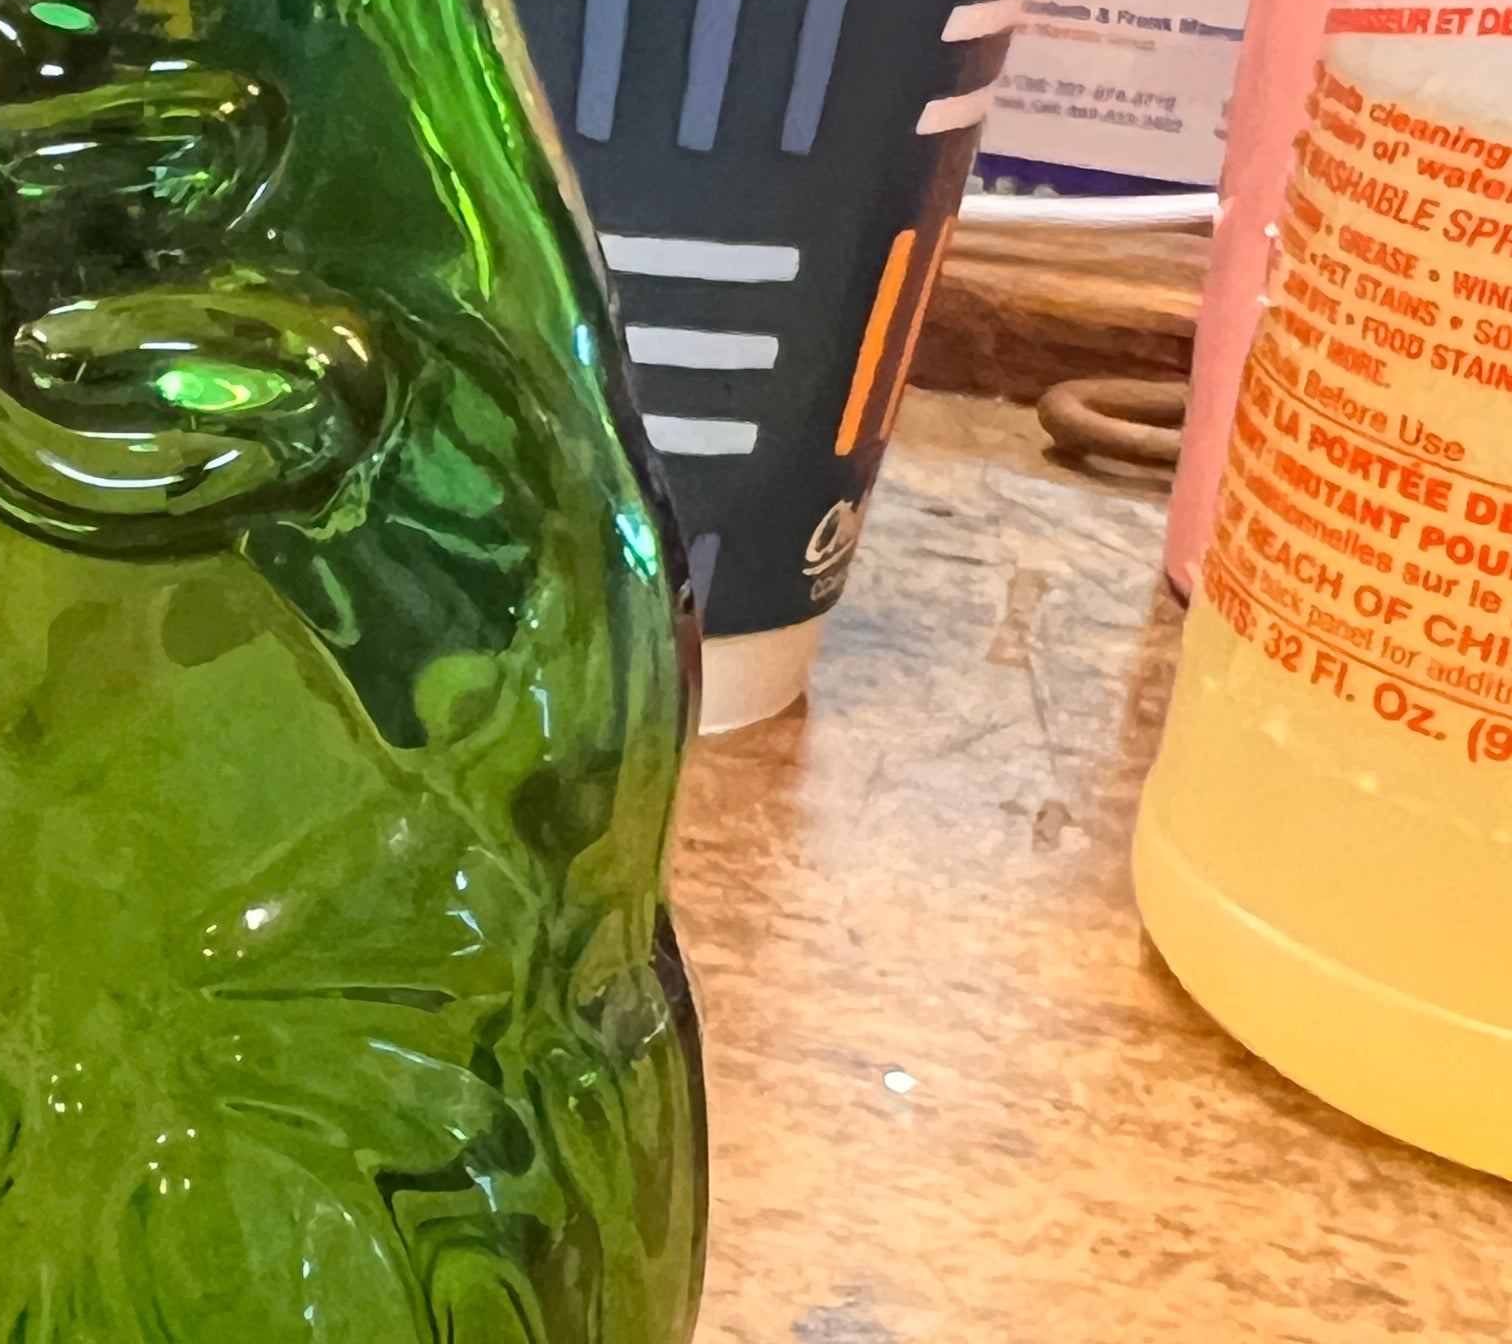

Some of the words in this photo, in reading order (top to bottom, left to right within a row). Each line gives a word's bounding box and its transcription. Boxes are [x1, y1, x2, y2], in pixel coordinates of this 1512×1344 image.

[1361, 315, 1425, 360] FOOD
[1399, 413, 1466, 462] Use
[1418, 525, 1512, 580] POU
[1354, 584, 1413, 624] OF
[1423, 613, 1512, 668] CHI
[1263, 622, 1303, 673] 32
[1373, 682, 1446, 741] Oz.
